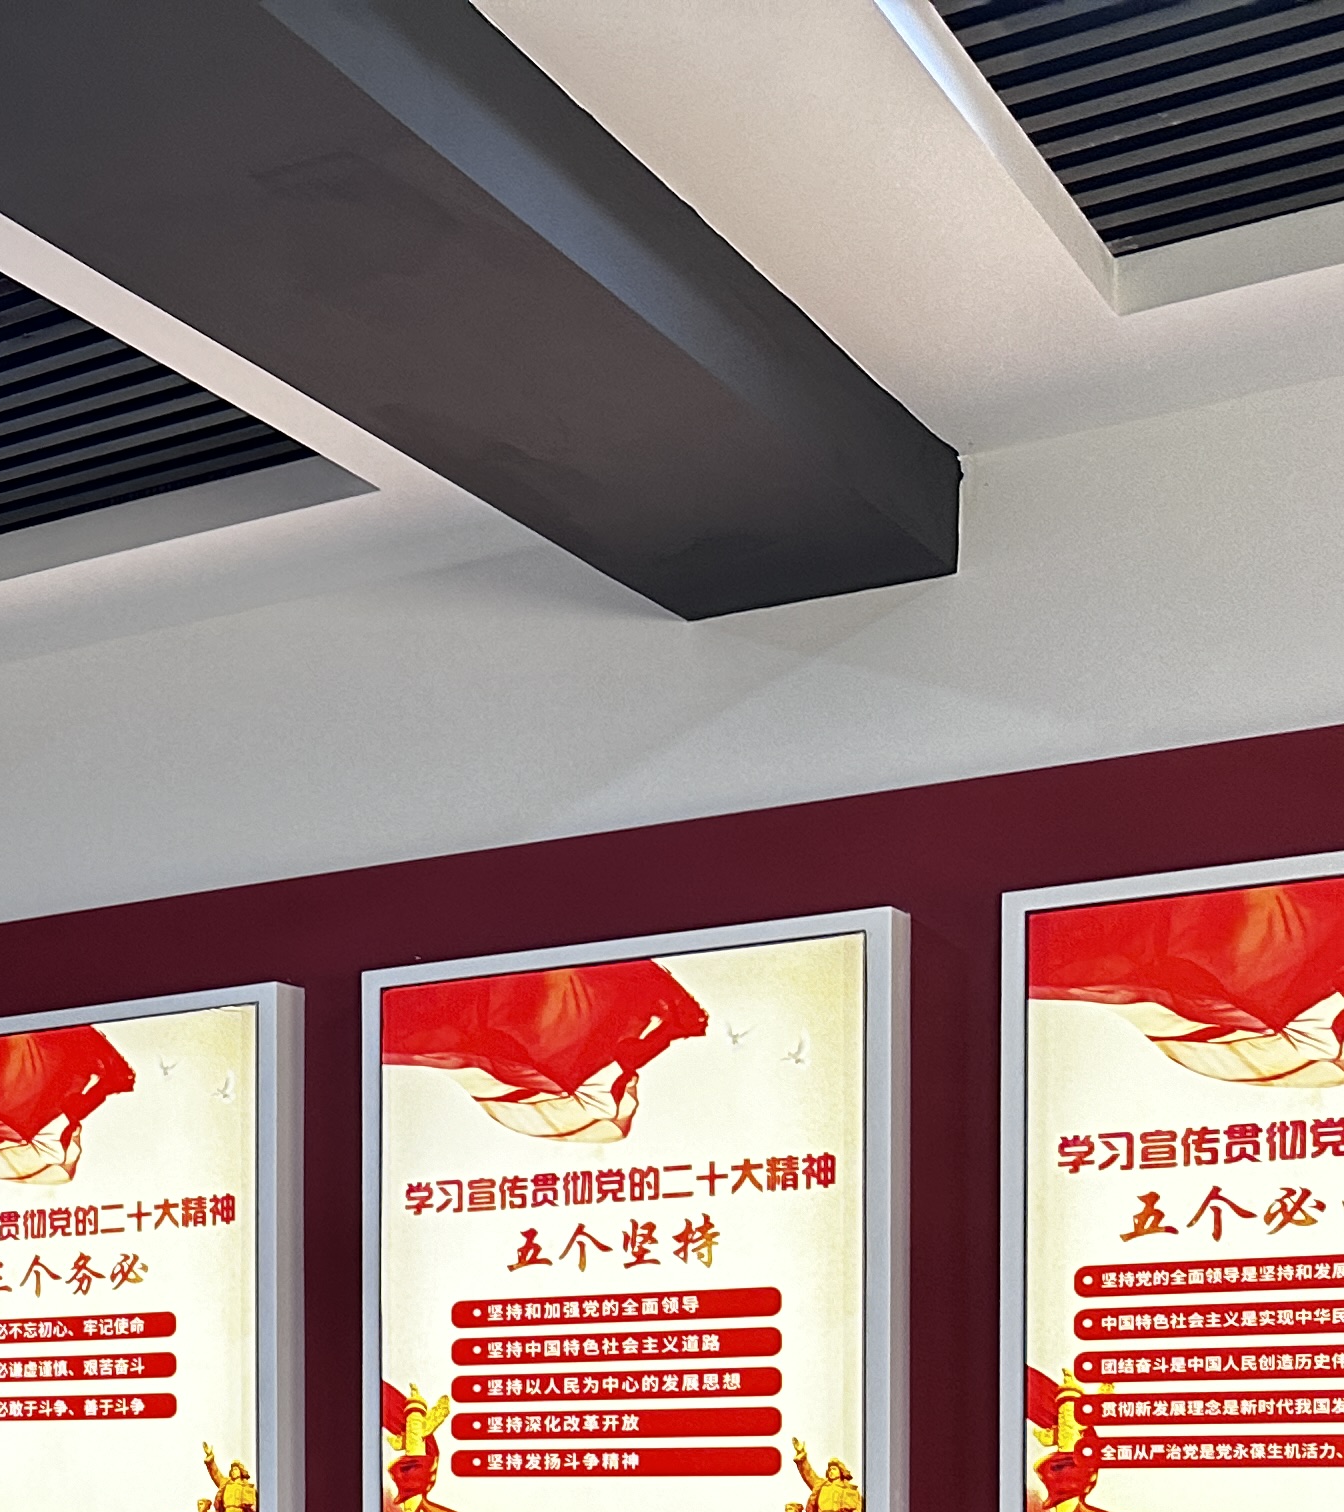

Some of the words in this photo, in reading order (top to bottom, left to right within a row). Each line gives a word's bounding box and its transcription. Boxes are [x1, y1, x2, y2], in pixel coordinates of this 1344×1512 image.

[1057, 1117, 1344, 1174] 学习宣传贯彻党
[405, 1152, 837, 1215] 学习宣传贯彻党的二十大精神
[507, 1213, 721, 1273] 五个坚持
[487, 1295, 700, 1322] 坚持和加强党的全面领导
[487, 1334, 721, 1359] 坚持中国特色社会主义道路
[487, 1373, 741, 1397] 坚持以人民为中心的发展思想
[487, 1414, 640, 1434] 坚持深化改革开放
[487, 1453, 640, 1471] 坚持发扬斗争精神
